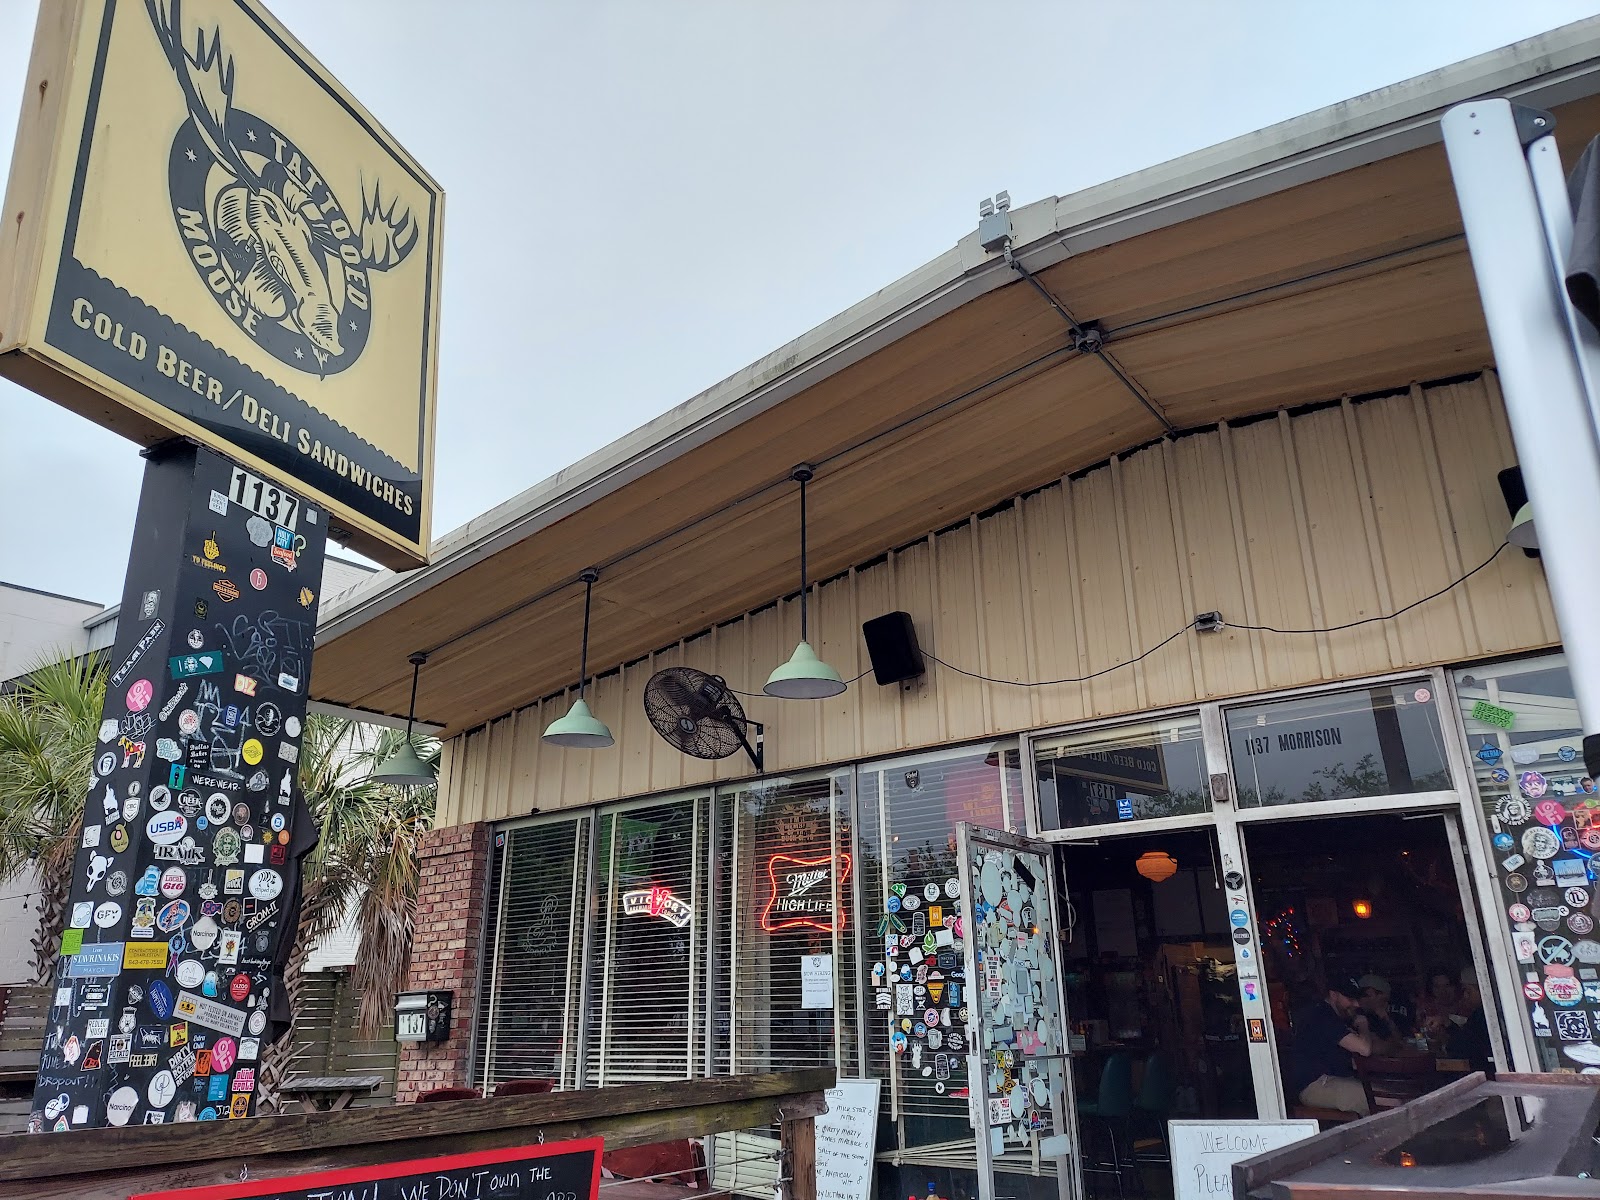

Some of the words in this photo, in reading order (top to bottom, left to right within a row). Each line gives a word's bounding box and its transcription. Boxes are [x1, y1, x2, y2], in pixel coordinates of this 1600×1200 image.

[270, 131, 368, 311] TATTOOED
[176, 206, 263, 336] MOOSE
[71, 297, 148, 361] COLD
[156, 343, 290, 445] BEER/DELI
[297, 427, 415, 517] SANDWICHES
[236, 472, 297, 526] 1137
[1245, 736, 1270, 756] 1137
[1278, 728, 1342, 752] MORRISON
[150, 820, 182, 834] USBA
[777, 898, 805, 911] HIGH
[807, 899, 832, 912] LIFE
[168, 1042, 191, 1068] DIRTY
[172, 1052, 196, 1078] ROTTEN
[1200, 1130, 1268, 1152] WELCOME
[435, 1171, 490, 1200] DON'T
[529, 1167, 552, 1183] THE
[1194, 1163, 1234, 1195] PLEA
